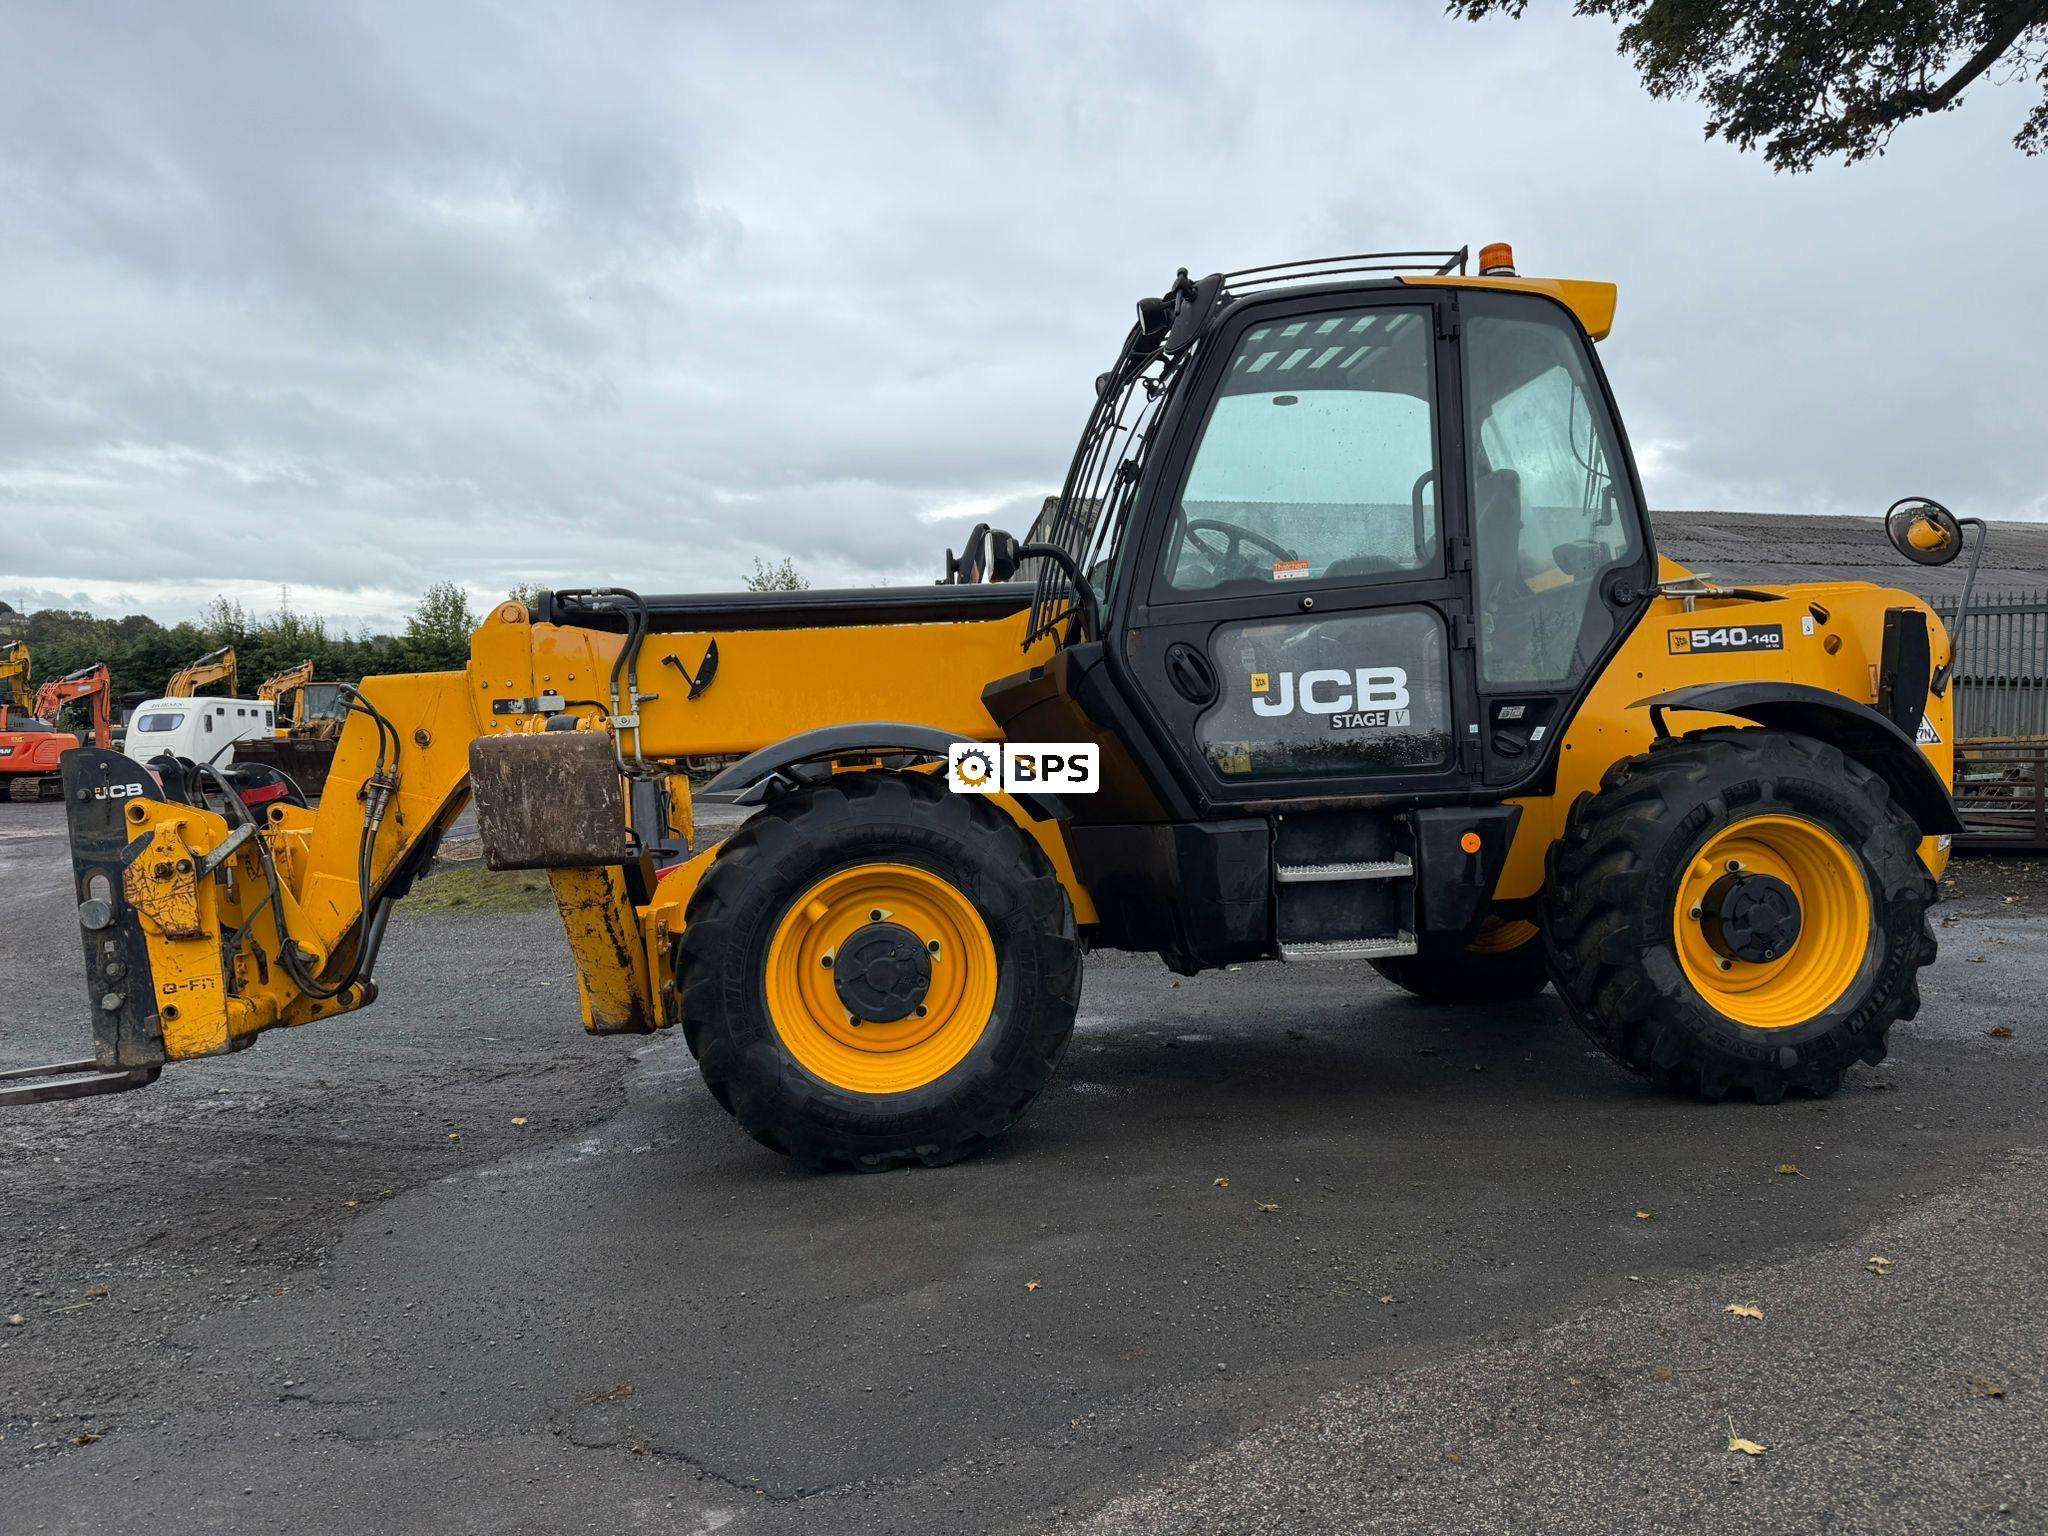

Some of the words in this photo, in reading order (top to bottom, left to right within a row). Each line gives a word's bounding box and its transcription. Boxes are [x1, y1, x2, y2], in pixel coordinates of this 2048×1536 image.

[1691, 627, 1779, 648] 540-140
[1252, 667, 1410, 717] JCB
[1332, 712, 1386, 729] STAGE
[1395, 710, 1405, 725] V
[95, 783, 143, 800] JCB
